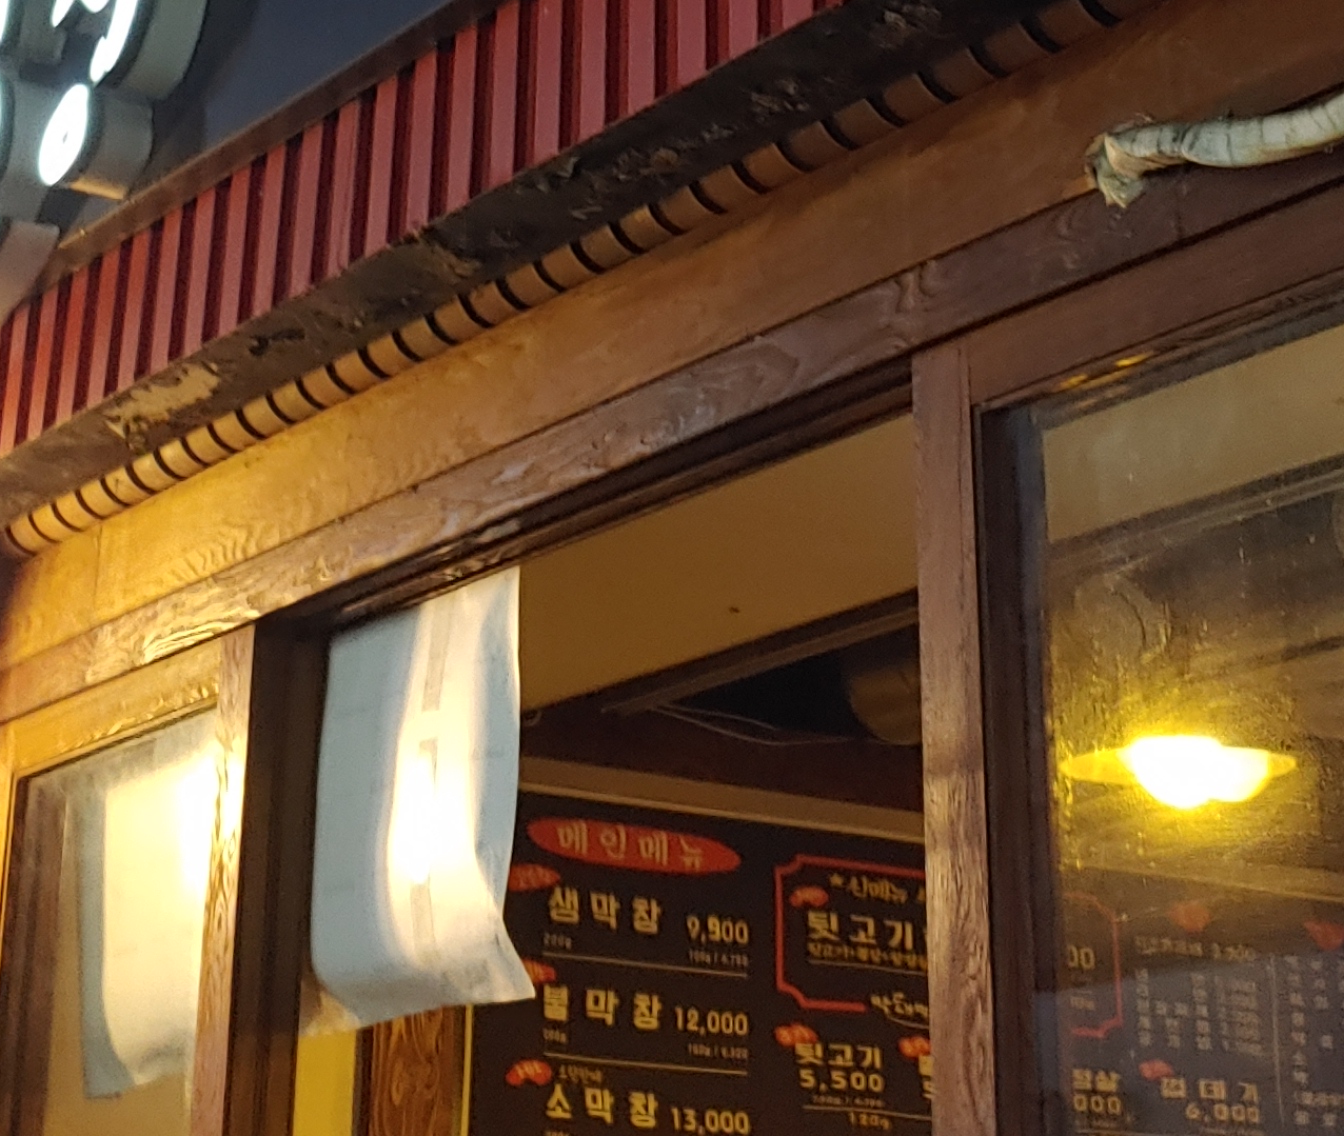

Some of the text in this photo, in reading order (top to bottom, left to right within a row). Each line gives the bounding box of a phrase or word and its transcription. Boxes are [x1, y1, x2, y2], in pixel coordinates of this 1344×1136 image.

[555, 820, 705, 870] 메인메뉴
[685, 914, 750, 947] 9,900
[674, 1006, 749, 1038] 12,000
[798, 1069, 886, 1095] 5,500
[545, 1082, 750, 1136] 소막창 13,000
